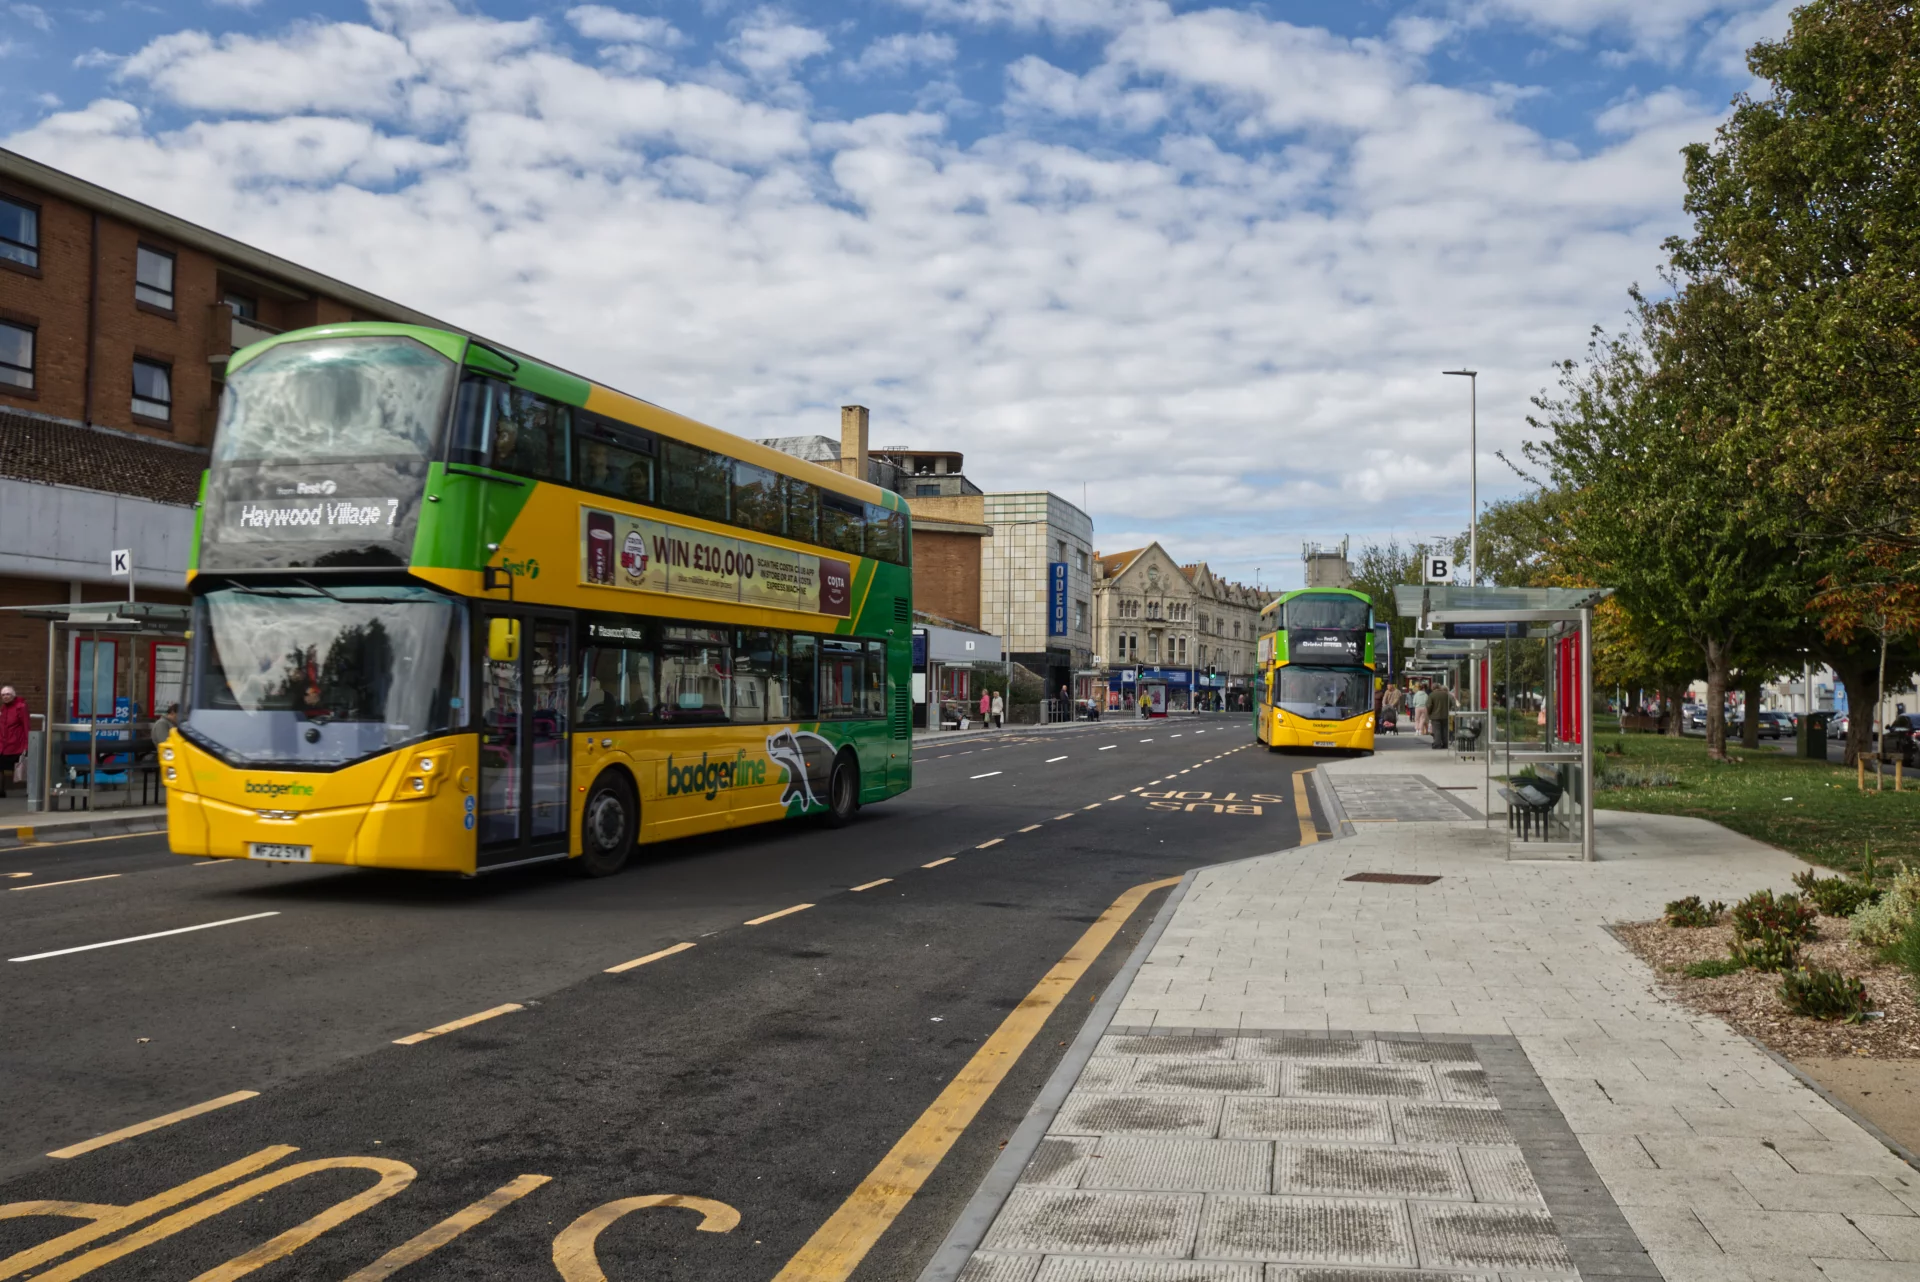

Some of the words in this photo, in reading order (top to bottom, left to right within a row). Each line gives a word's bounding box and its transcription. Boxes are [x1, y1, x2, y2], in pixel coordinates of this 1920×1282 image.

[240, 504, 322, 528] Haywood
[327, 502, 381, 526] Village
[386, 500, 398, 525] 7
[115, 554, 126, 570] K
[652, 534, 690, 568] WIN
[694, 544, 754, 579] £10,000
[780, 563, 794, 572] COSTA
[795, 565, 806, 575] CUB
[1432, 560, 1448, 577] B
[786, 584, 807, 595] MACHNE
[827, 576, 845, 588] COSTA
[1056, 565, 1064, 632] ODEON
[667, 748, 766, 801] badgerline
[245, 779, 314, 798] badgerline
[1139, 790, 1283, 803] STOP
[1145, 801, 1262, 815] BUS
